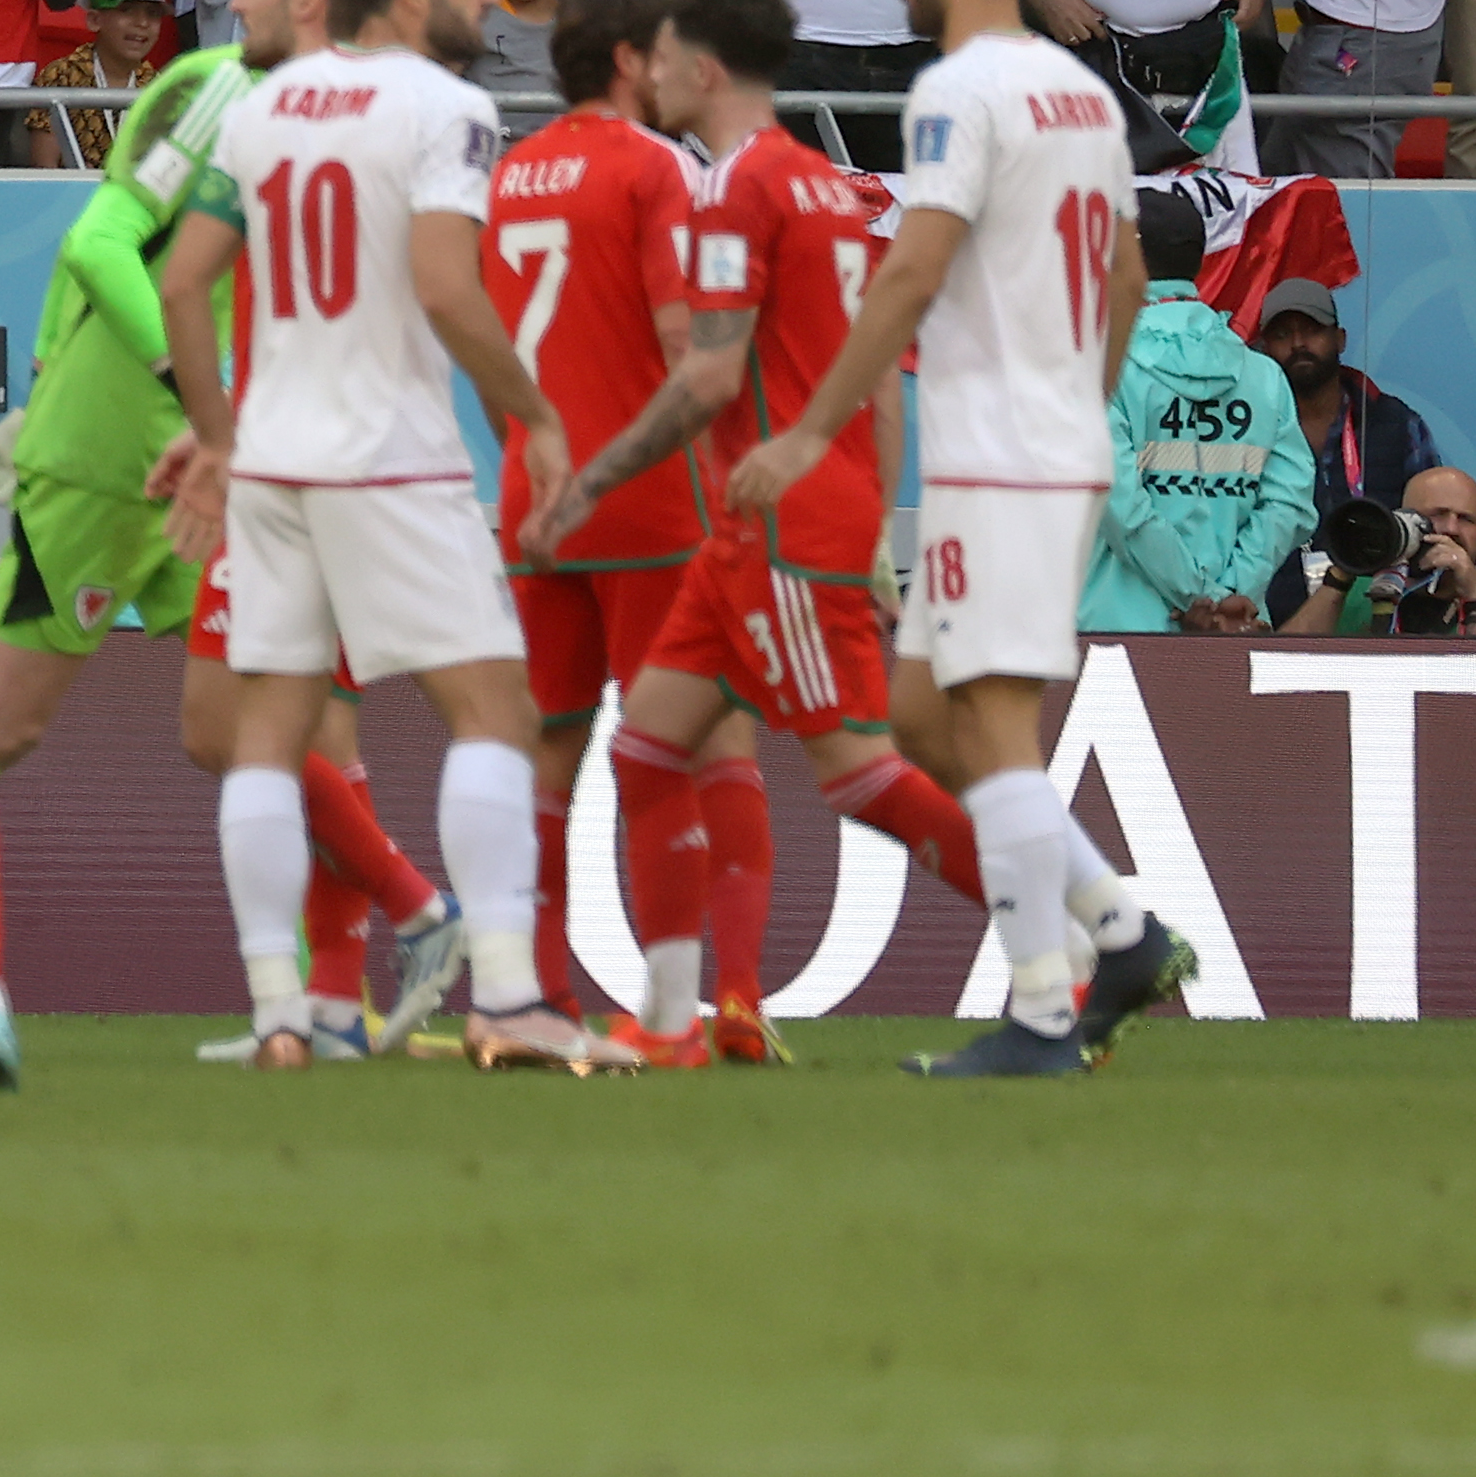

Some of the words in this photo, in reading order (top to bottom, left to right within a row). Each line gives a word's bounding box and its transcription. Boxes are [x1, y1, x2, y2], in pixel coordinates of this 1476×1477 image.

[498, 155, 588, 200] ALLEN
[258, 158, 358, 321] 10
[498, 217, 571, 386] 7
[925, 536, 968, 604] 18
[745, 611, 784, 686] 3
